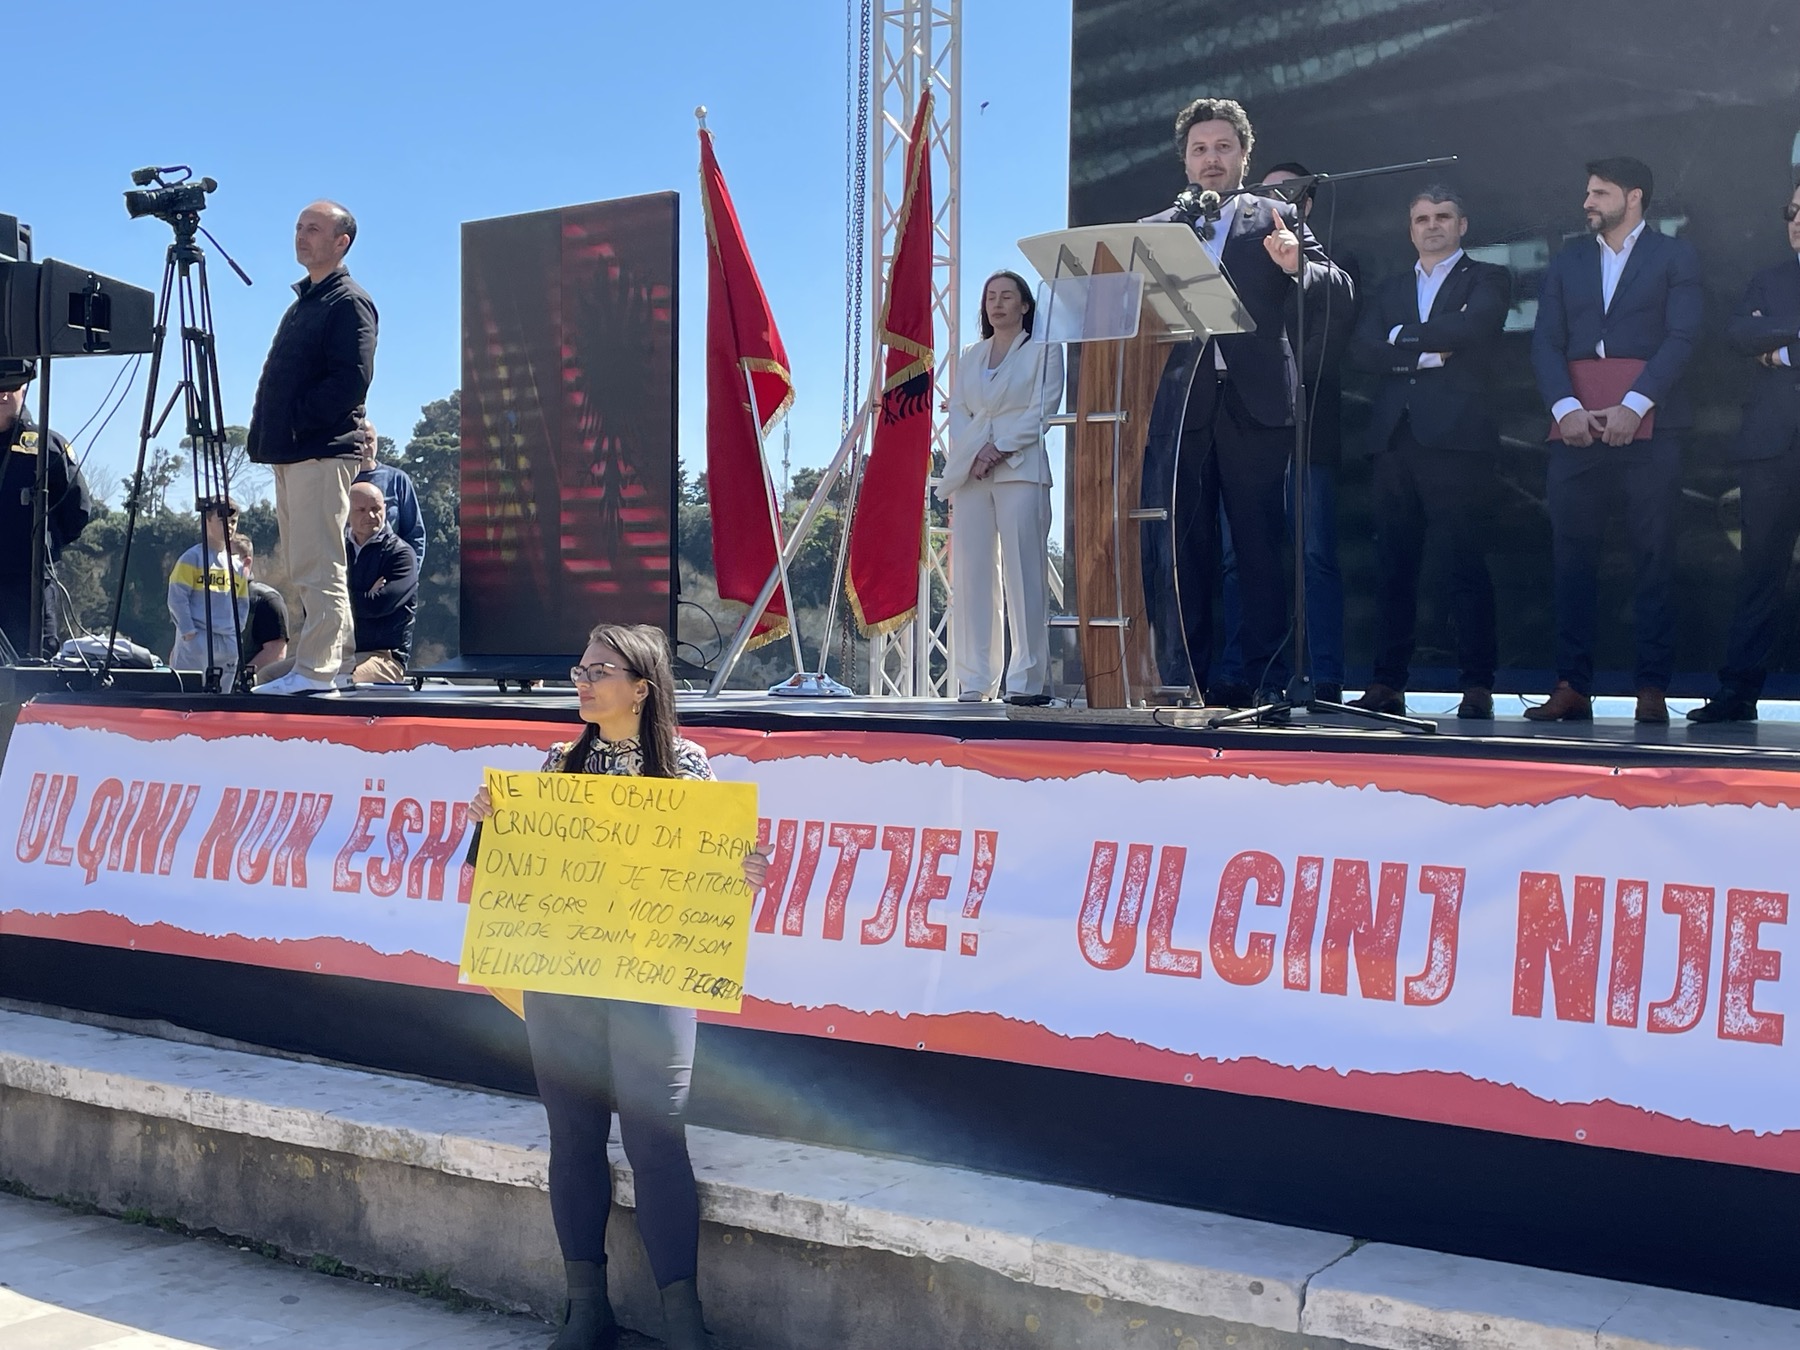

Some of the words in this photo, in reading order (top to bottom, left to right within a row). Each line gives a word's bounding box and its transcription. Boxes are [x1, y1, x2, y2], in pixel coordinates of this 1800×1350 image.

[489, 773, 523, 799] NE
[537, 775, 598, 804] MOŽE
[611, 783, 686, 812] OBALU
[493, 809, 640, 846] CRNOGORSKU
[652, 825, 683, 849] DA
[485, 849, 547, 877] ONAJ
[561, 858, 607, 883] KOJI
[619, 864, 652, 891] JE
[16, 773, 201, 885] ULQINI
[194, 787, 333, 888] NUK
[332, 778, 476, 904] ËSH
[750, 817, 998, 956] HITJE!
[1078, 840, 1466, 1006] ULCINJ
[1512, 871, 1789, 1046] NIJE
[479, 890, 534, 912] CRNE
[629, 898, 673, 924] 1000
[679, 908, 735, 930] GODINA
[477, 920, 551, 939] ISTORIJE
[566, 924, 637, 943] JEDNIM
[645, 929, 732, 956] POTPISOM
[471, 946, 602, 976] VELIKODUŠNO
[615, 955, 676, 985] PREDAO
